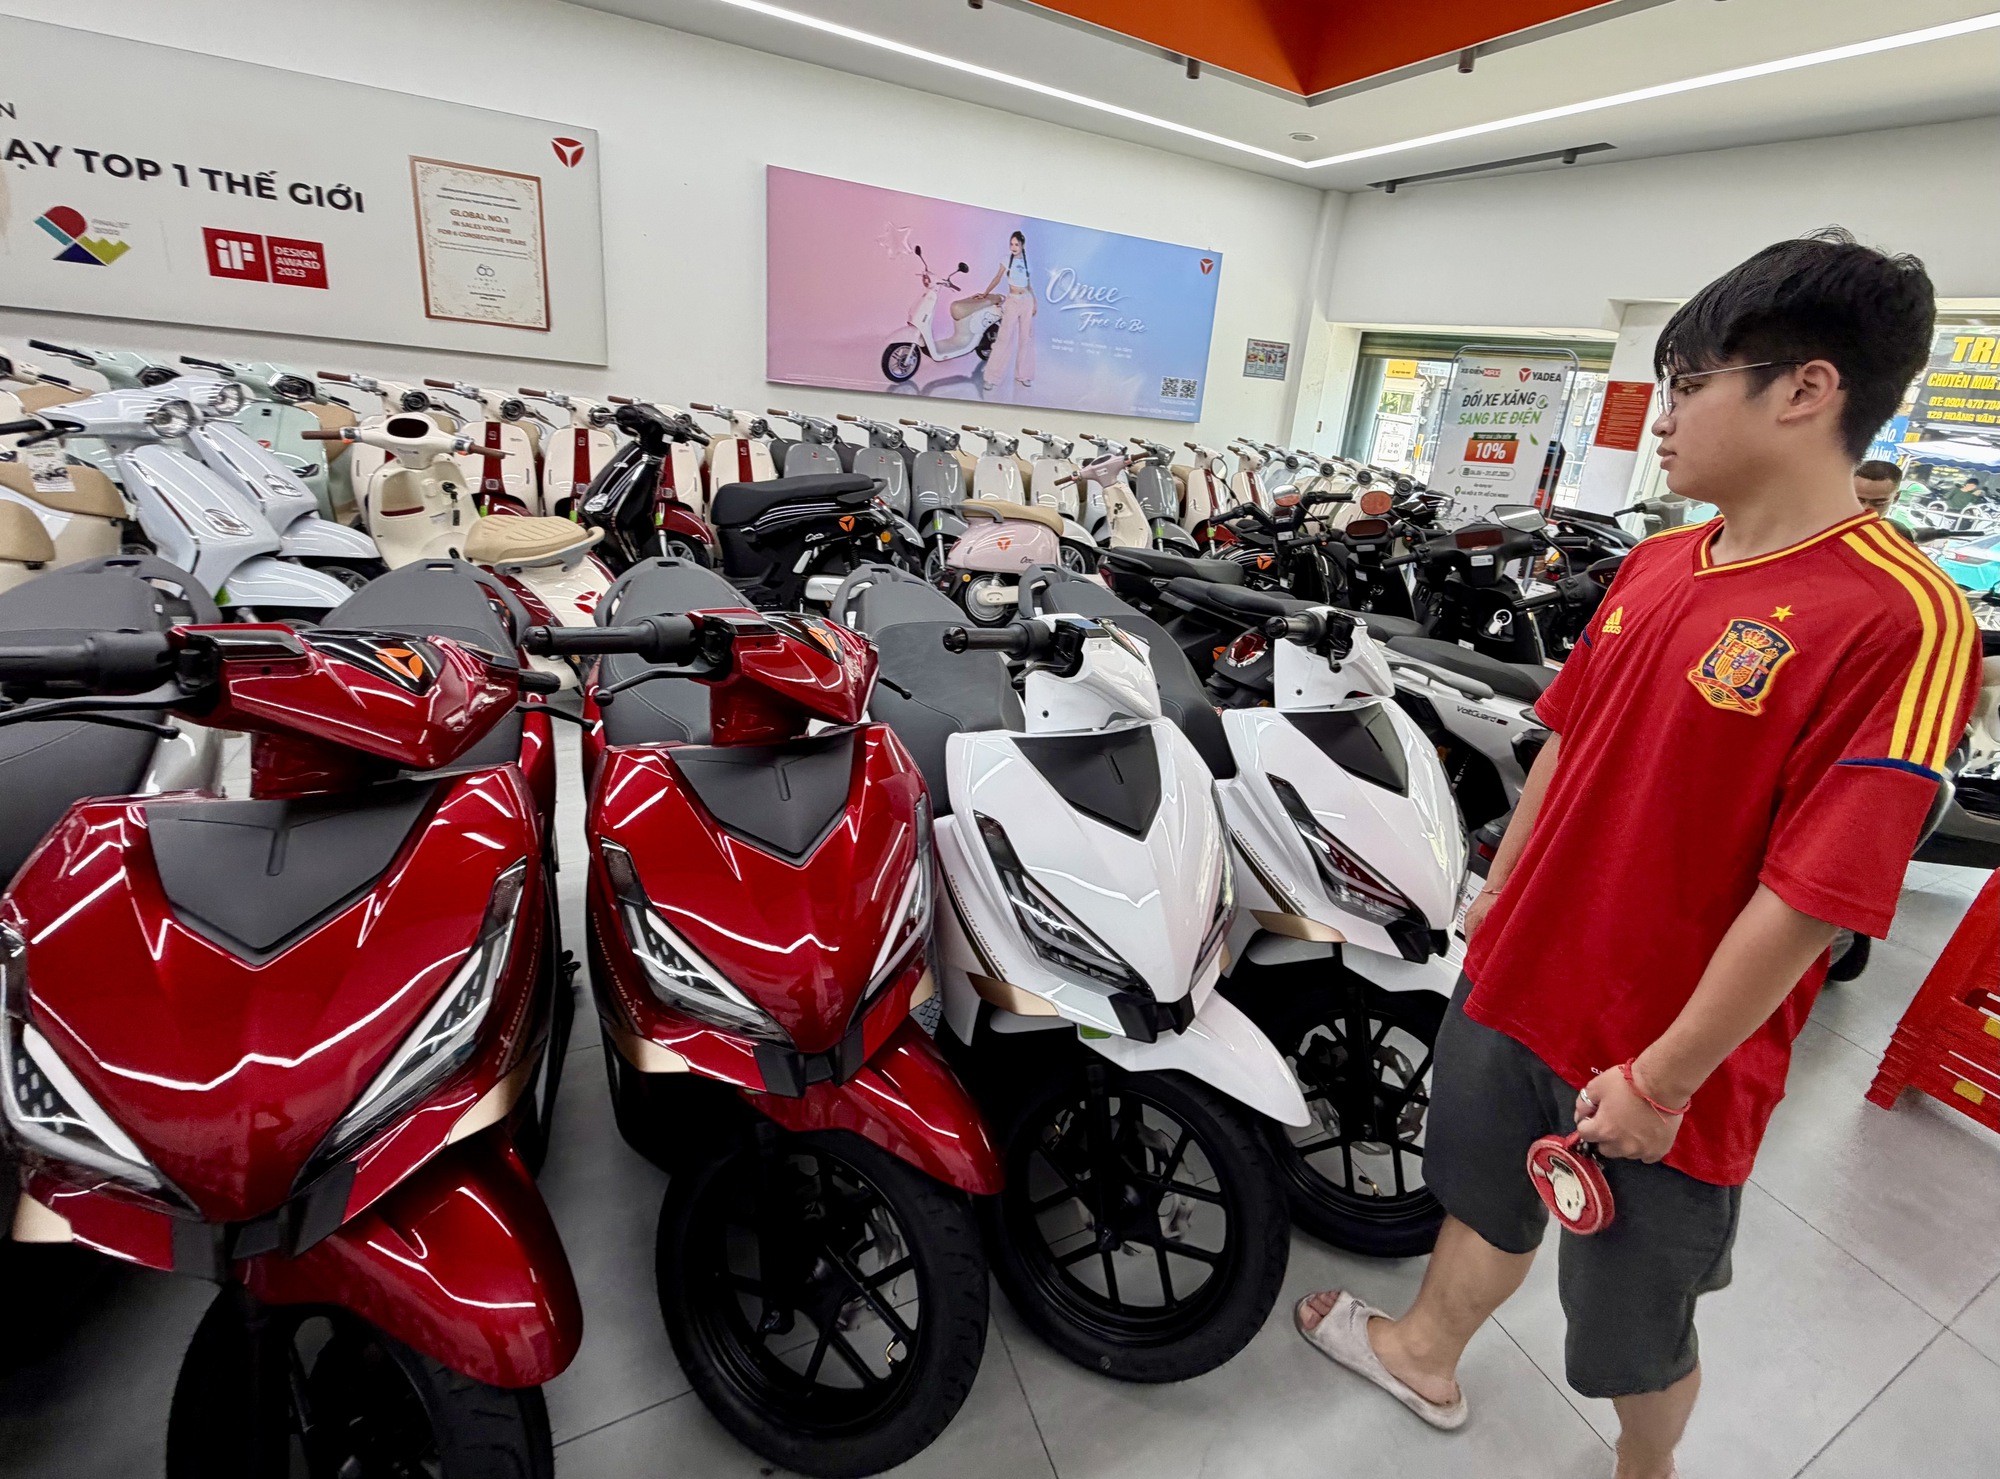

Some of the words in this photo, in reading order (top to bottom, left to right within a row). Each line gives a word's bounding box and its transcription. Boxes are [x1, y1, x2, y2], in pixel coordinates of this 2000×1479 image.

[0, 138, 62, 170] ẠY
[73, 148, 162, 181] TOP
[172, 163, 190, 188] 1
[198, 170, 278, 201] THẾ
[288, 183, 365, 213] GIỚI
[449, 208, 485, 221] GLOBAL
[274, 246, 317, 260] DESIGN
[275, 258, 321, 270] AWARD
[276, 266, 306, 278] 2023
[1046, 267, 1130, 304] Omee
[1078, 311, 1109, 332] Free
[1114, 317, 1127, 330] to
[1128, 319, 1150, 333] Be
[1532, 371, 1562, 383] YADEA
[1927, 372, 1970, 388] CHUYÊN
[1482, 393, 1501, 407] XE
[1501, 388, 1537, 406] XĂNG
[1458, 412, 1490, 425] SANG
[1490, 411, 1509, 425] XE
[1509, 407, 1543, 427] ĐIỆN
[1475, 442, 1507, 460] 10%
